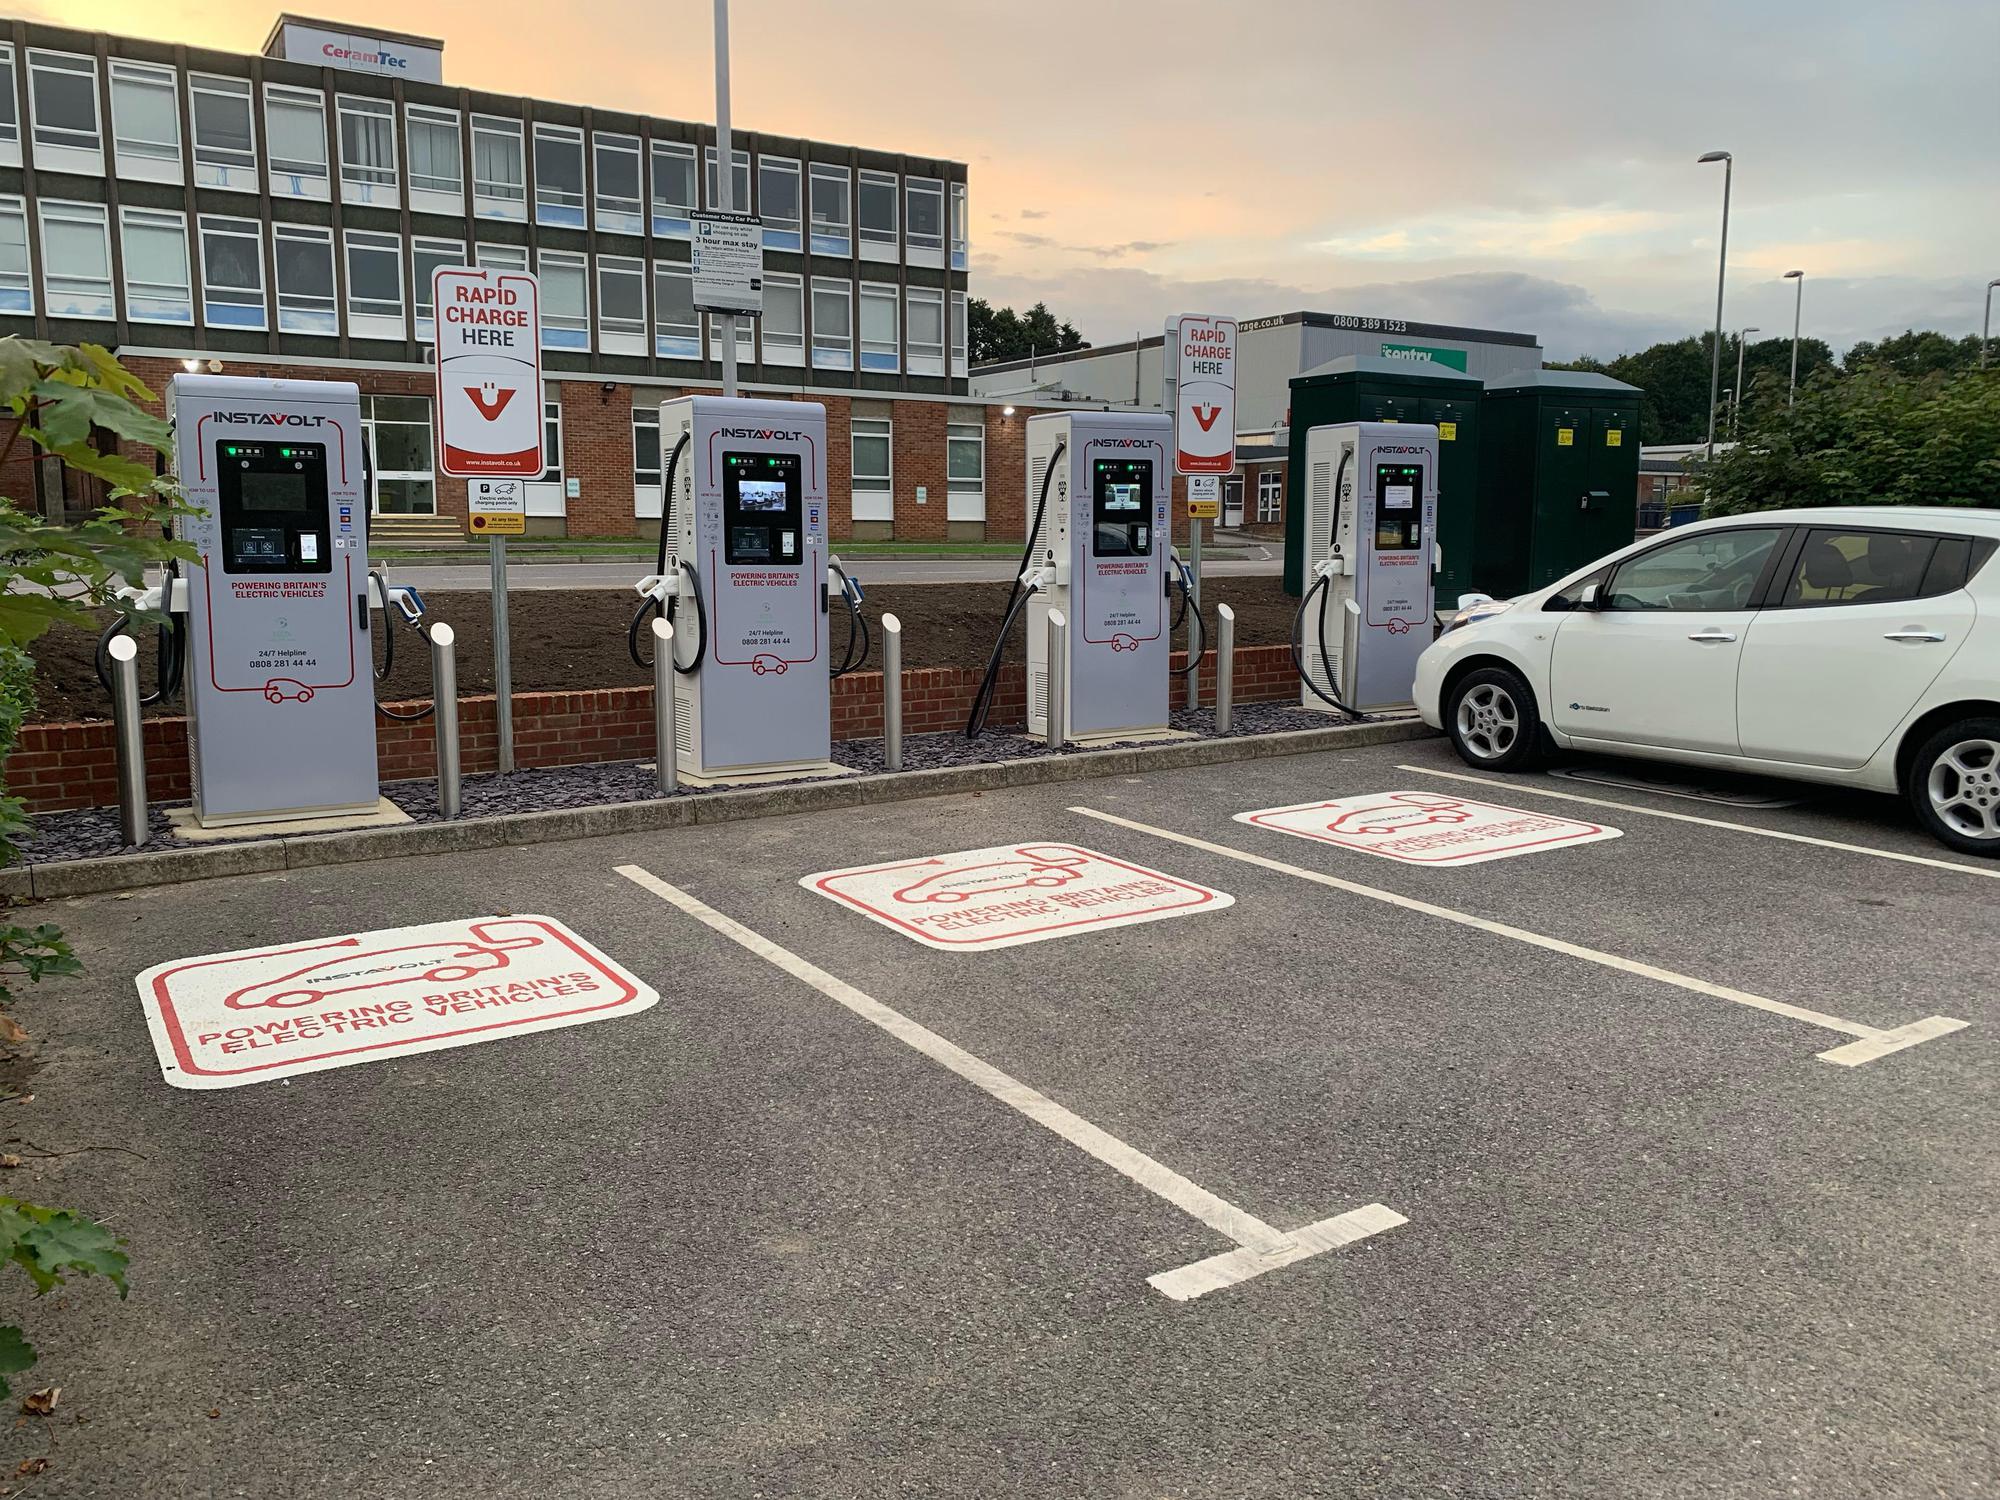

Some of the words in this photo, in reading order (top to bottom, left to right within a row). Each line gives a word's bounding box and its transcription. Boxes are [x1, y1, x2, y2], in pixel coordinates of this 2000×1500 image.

[322, 43, 407, 68] CeramTec
[691, 211, 720, 219] Customer
[703, 237, 720, 245] hour
[742, 241, 758, 249] stay
[456, 286, 517, 305] RAPID
[446, 306, 528, 327] CHARGE
[1334, 316, 1359, 327] 0800
[1362, 318, 1380, 329] 389
[1383, 320, 1406, 331] 1523
[463, 328, 514, 347] HERE
[1191, 329, 1226, 343] RAPID
[1185, 345, 1231, 359] CHARGE
[1193, 361, 1223, 374] HERE
[214, 411, 326, 427] INSTAVOLT
[721, 428, 802, 440] INSTAVOLT
[1093, 439, 1154, 448] INSTAVOLT
[1377, 446, 1425, 454] INSTAVOLT
[235, 590, 278, 598] ELECTRIC
[249, 660, 272, 668] 0808
[910, 899, 1047, 925] POWERING
[1047, 880, 1160, 902] BRITAIN'S
[937, 905, 1060, 930] ELECTRIC
[1060, 886, 1176, 908] VEHICLES
[306, 958, 447, 984] INSTAVOLT
[198, 1001, 413, 1045] POWERING
[423, 972, 592, 1006] BRITAIN'S
[220, 1012, 414, 1054] ELECTRIC
[425, 981, 600, 1016] VEHICLES
